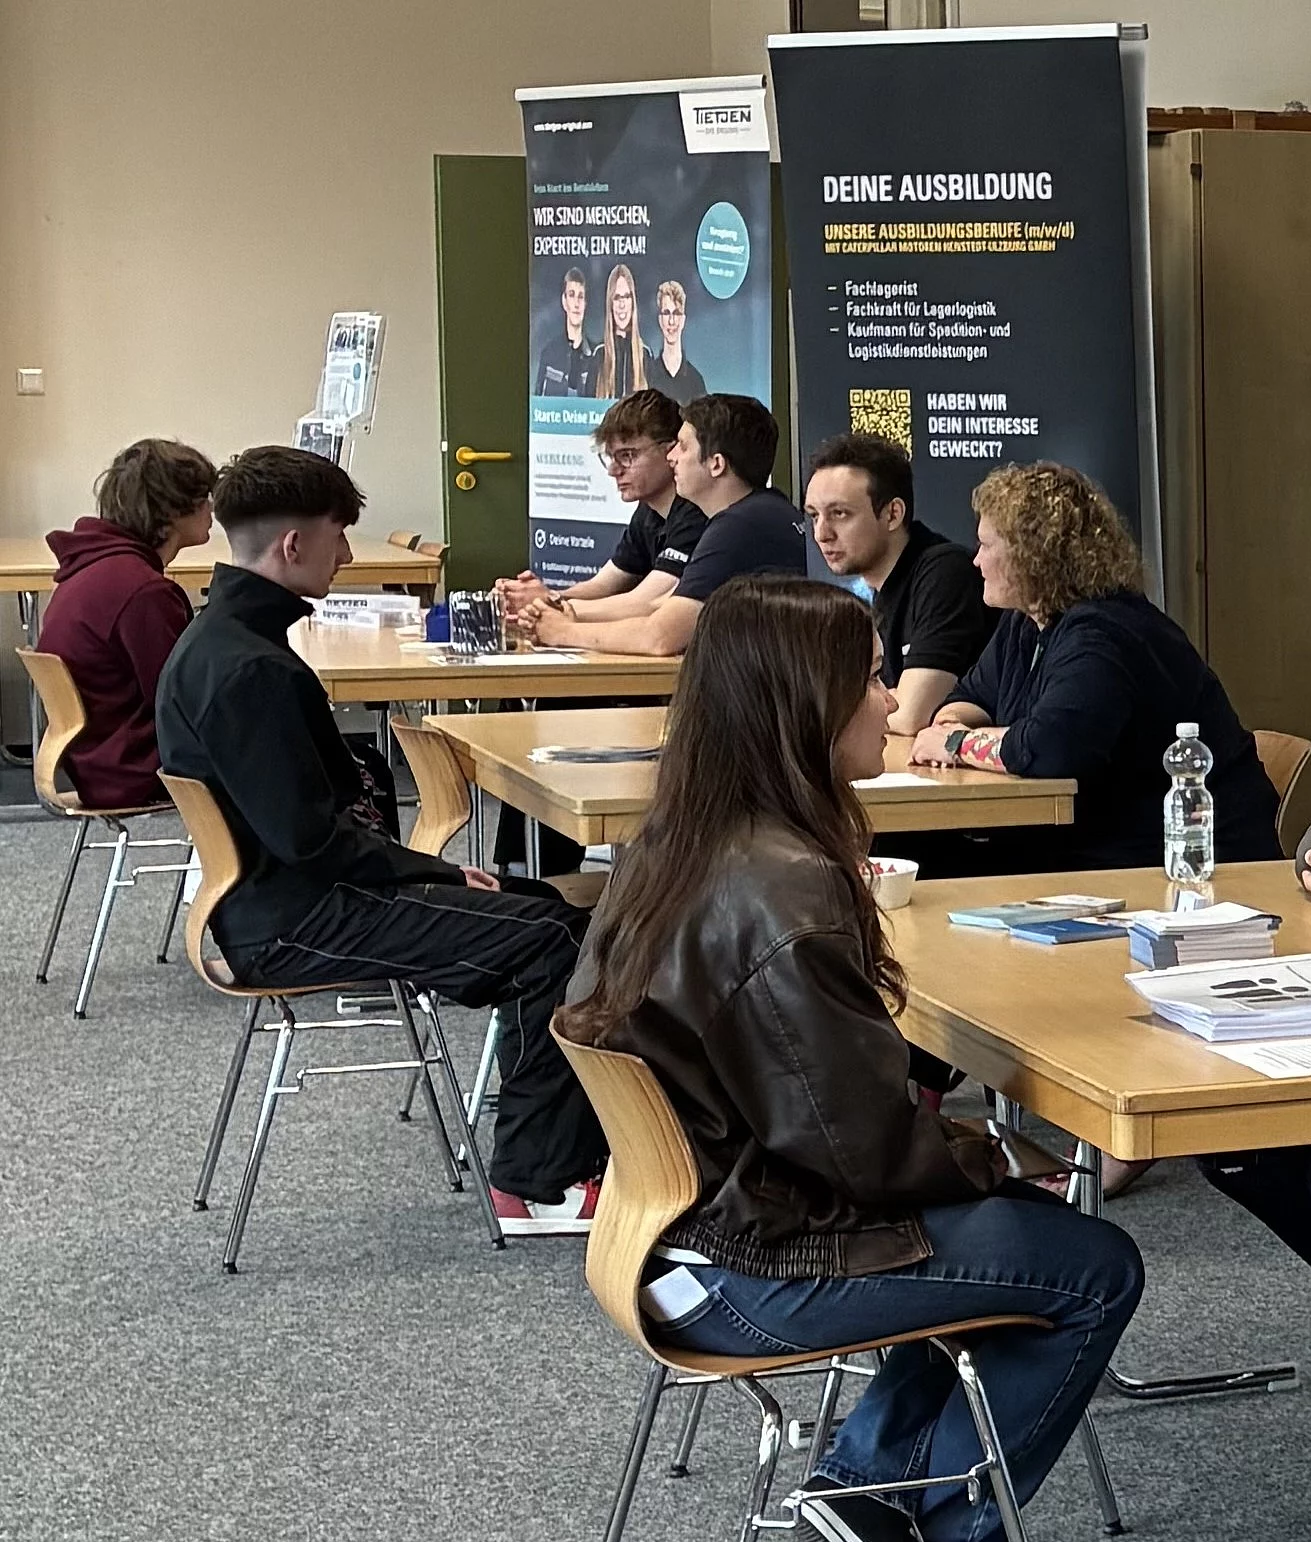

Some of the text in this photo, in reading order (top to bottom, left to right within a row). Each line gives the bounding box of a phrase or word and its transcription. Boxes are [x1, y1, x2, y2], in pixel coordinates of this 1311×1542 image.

[693, 105, 752, 125] TIETJEN
[823, 172, 1053, 202] DEINE AUSBILDUNG
[534, 205, 651, 227] WIR SIND MENSCHEN,
[825, 221, 1075, 240] UNSERE AUSBILDUNGSBERUFE (m/w/d)
[534, 235, 647, 258] EXPERTEN, EIN TEAM!
[845, 280, 918, 299] Fachlagerist
[846, 301, 997, 319] Fachkraft für Lagerlogistik
[847, 322, 906, 338] Kaufmann
[909, 321, 926, 337] für
[990, 321, 1011, 337] und
[848, 342, 988, 361] Logistikdienstleistungen
[927, 393, 1007, 411] HABEN WIR
[928, 416, 1039, 435] DEIN INTERESSE
[929, 440, 1003, 458] GEWECKT?
